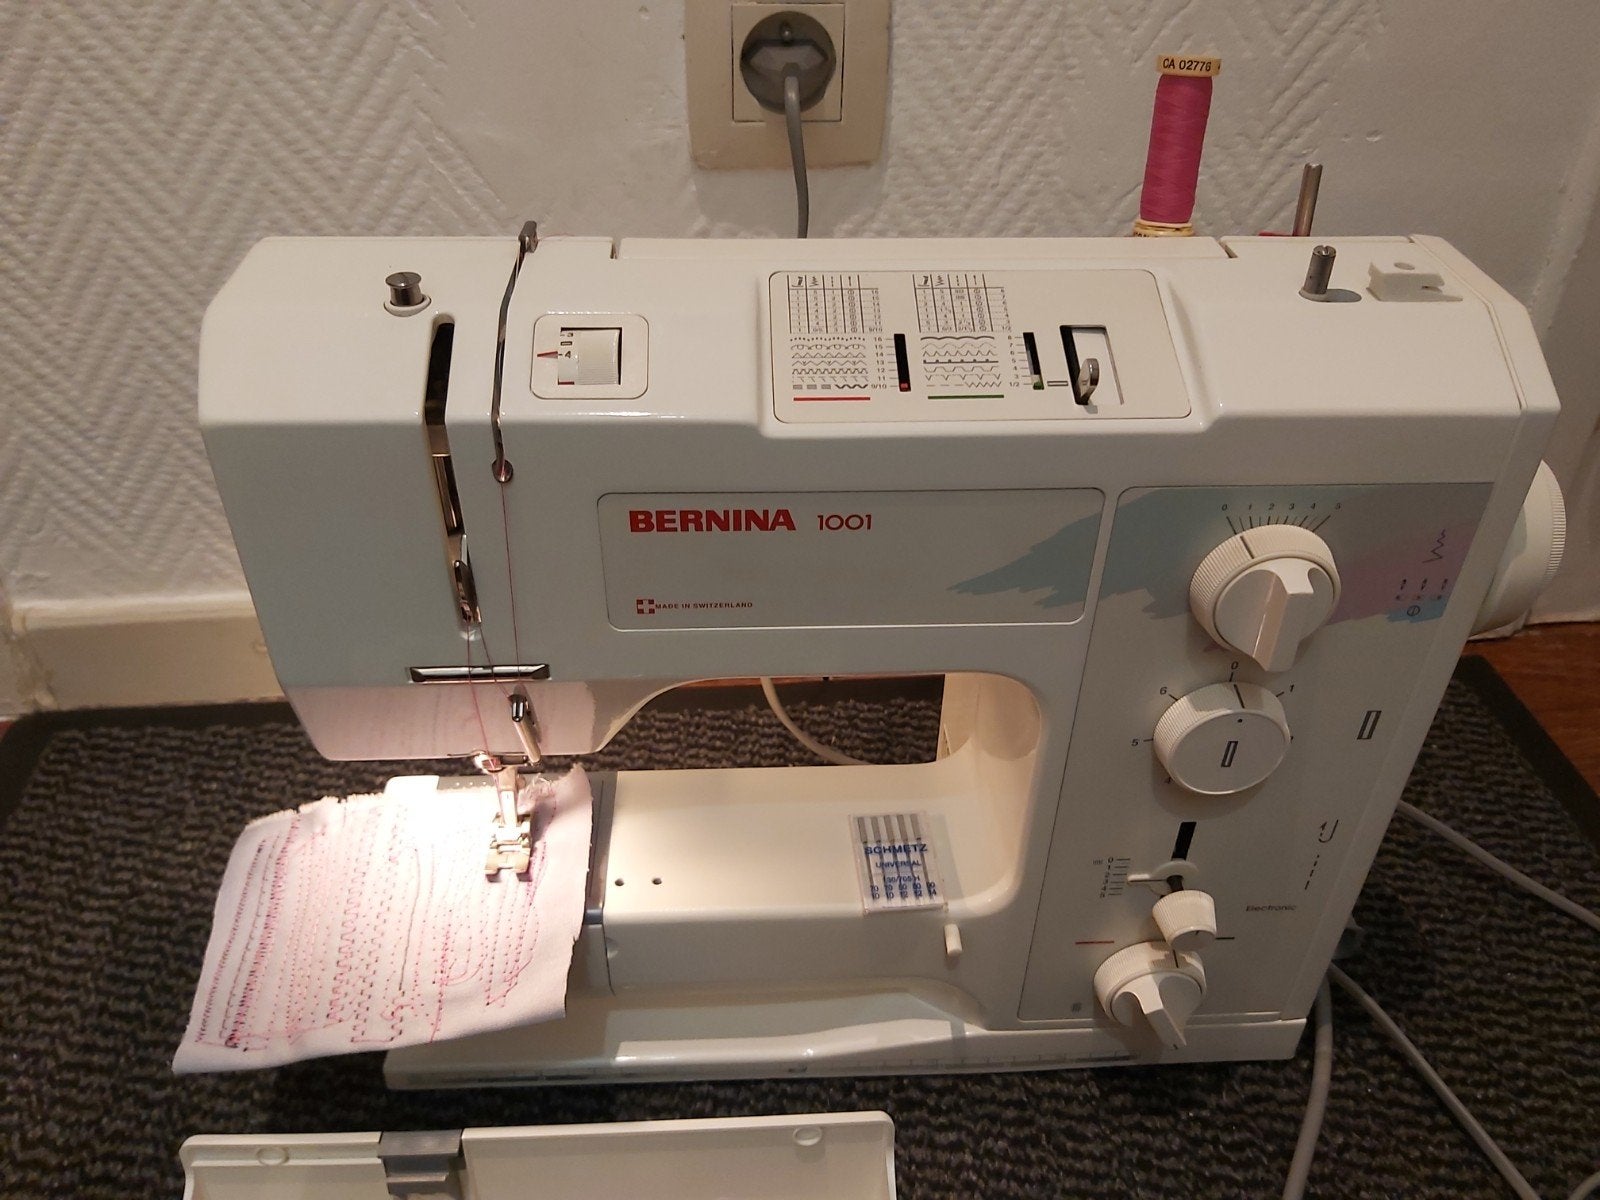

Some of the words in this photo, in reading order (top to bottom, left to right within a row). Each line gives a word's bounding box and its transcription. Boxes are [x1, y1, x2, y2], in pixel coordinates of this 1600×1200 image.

[1162, 58, 1176, 70] CA
[1178, 60, 1212, 72] 02776
[629, 510, 796, 532] BERNINA
[817, 514, 872, 530] 1001
[1231, 661, 1239, 670] 0
[1160, 686, 1168, 694] 6
[1289, 684, 1294, 692] 1
[1131, 739, 1139, 747] 5
[864, 844, 928, 854] SCHMETZ
[876, 860, 922, 868] UNIVERSAL
